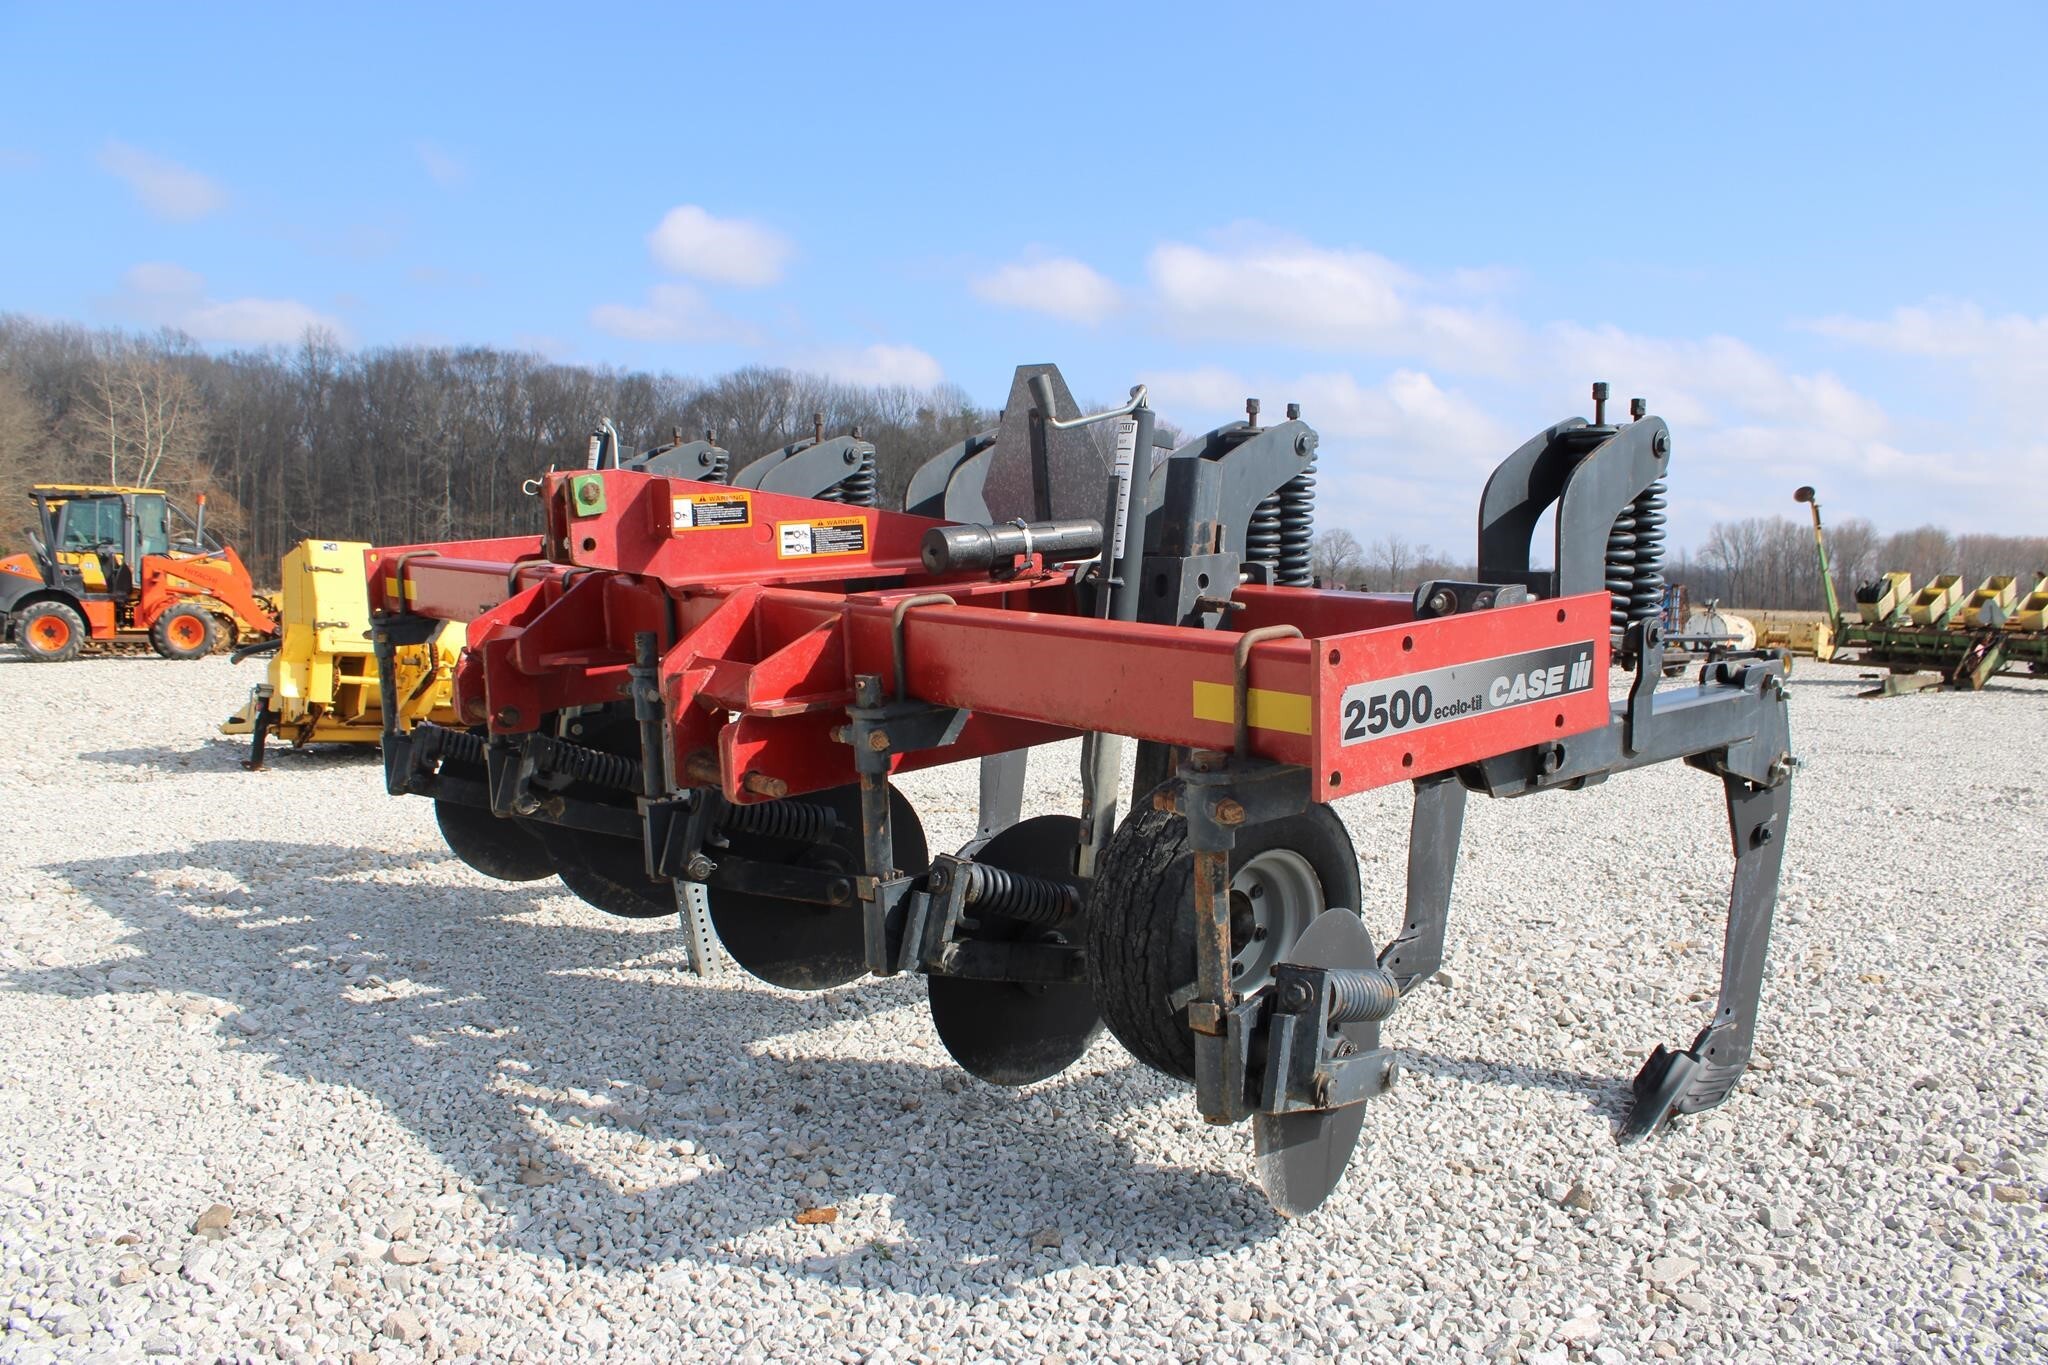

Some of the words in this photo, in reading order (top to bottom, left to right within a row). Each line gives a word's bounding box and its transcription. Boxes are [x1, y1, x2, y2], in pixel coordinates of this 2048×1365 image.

[708, 494, 745, 502] WARNING
[826, 518, 860, 526] WARNING
[183, 567, 218, 584] HITACHI
[1344, 685, 1433, 741] 2500
[1488, 664, 1566, 707] CASE
